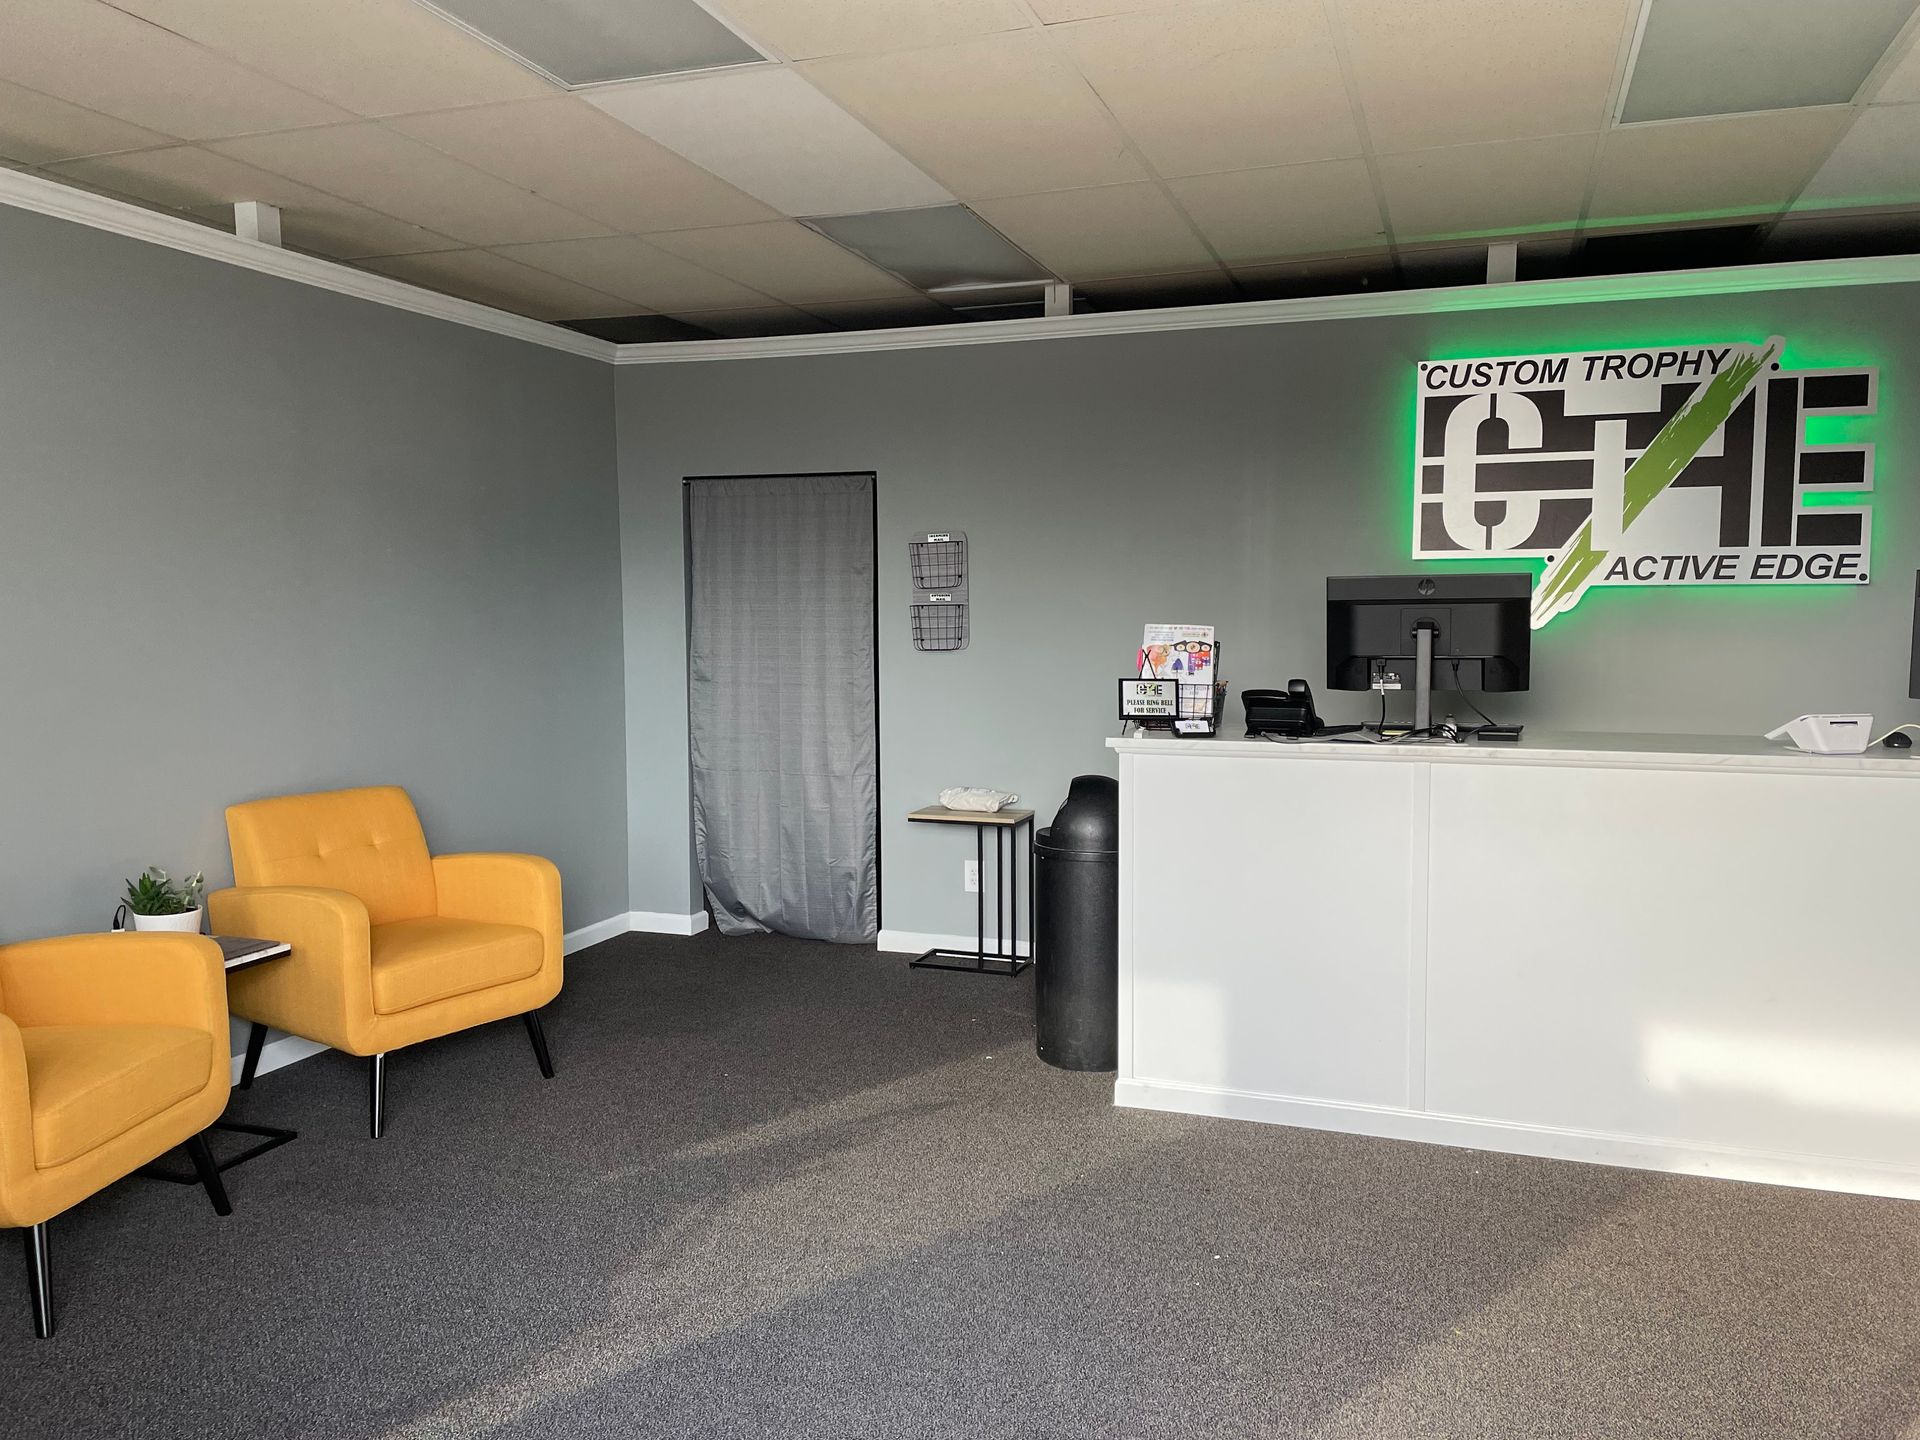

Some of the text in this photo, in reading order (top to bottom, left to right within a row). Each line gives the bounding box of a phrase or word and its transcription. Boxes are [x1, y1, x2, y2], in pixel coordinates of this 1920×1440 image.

[1425, 348, 1732, 390] CUSTOM TROPHY
[1604, 553, 1738, 582] ACTIVE
